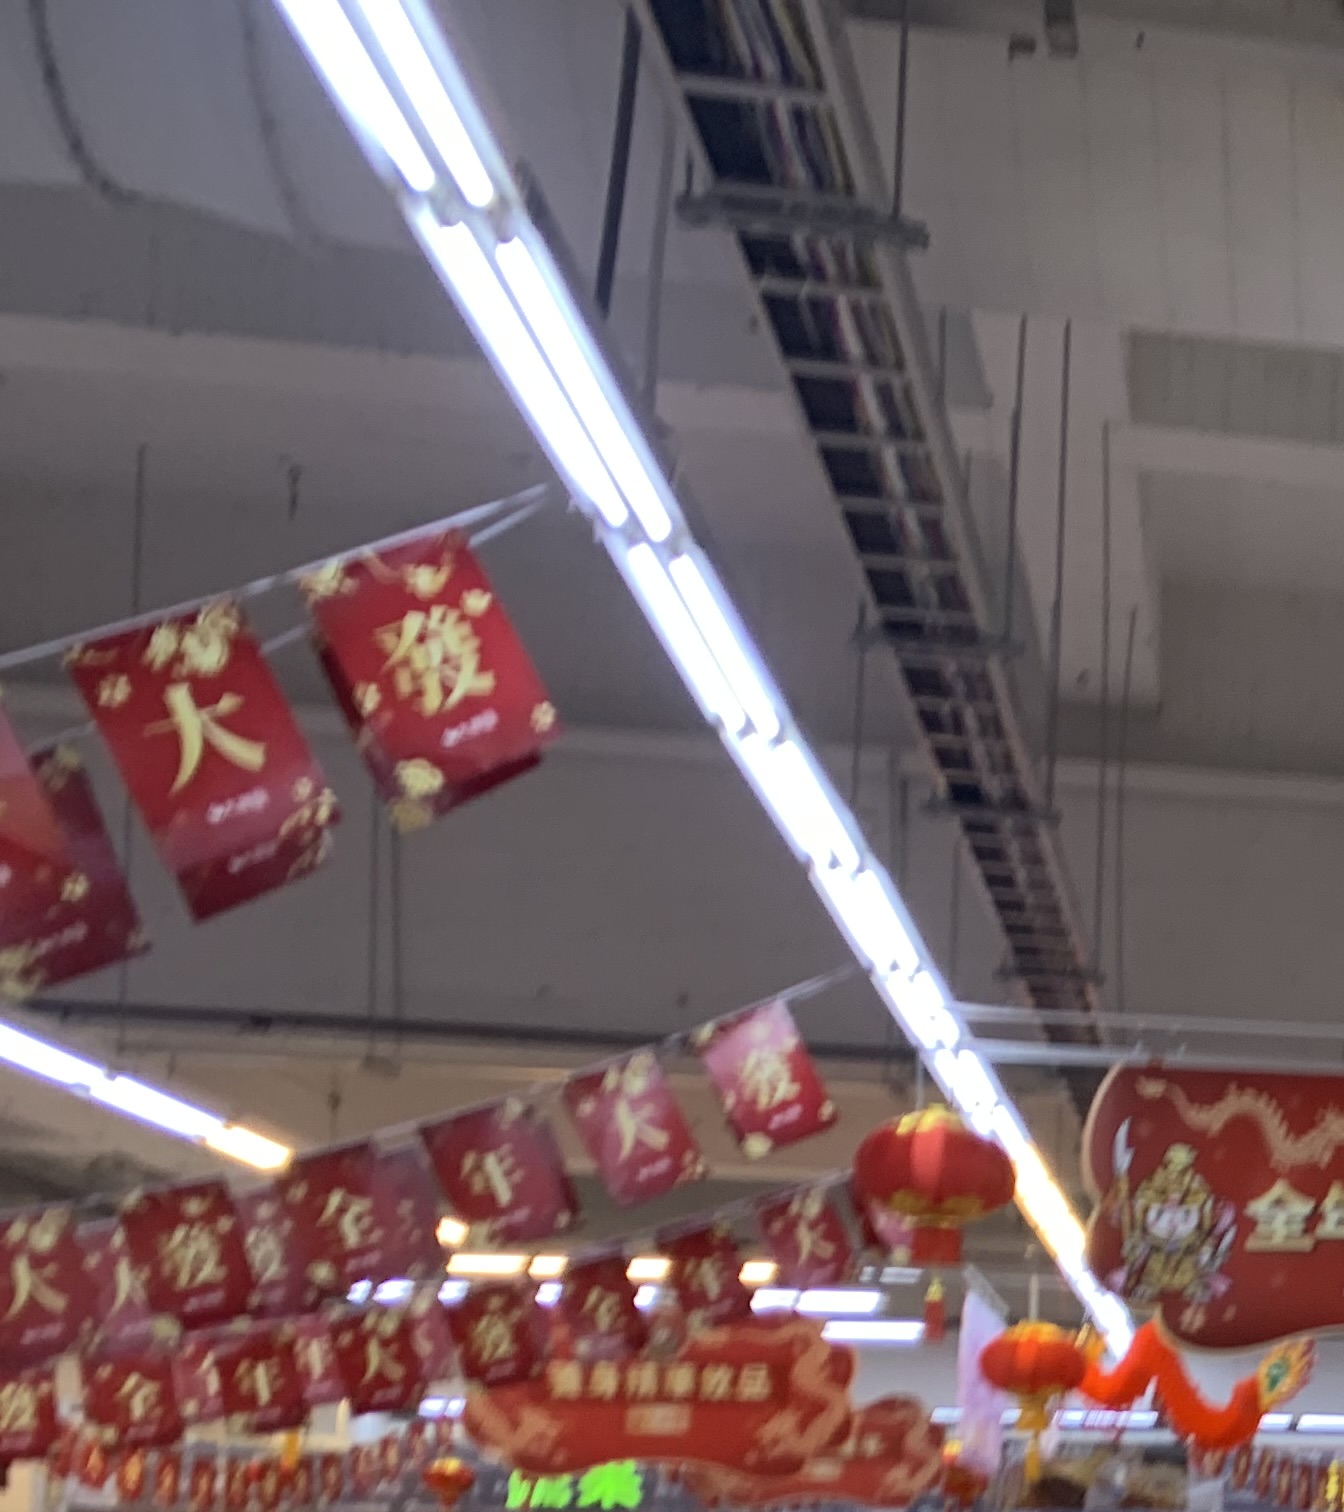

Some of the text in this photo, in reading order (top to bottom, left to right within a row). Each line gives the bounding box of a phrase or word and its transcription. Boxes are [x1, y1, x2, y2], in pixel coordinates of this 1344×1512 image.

[374, 605, 495, 717] 發
[144, 683, 266, 796] 大
[738, 1046, 800, 1109] 發
[613, 1097, 670, 1162] 大
[461, 1142, 527, 1207] 年
[4, 1255, 69, 1320] 大
[158, 1223, 227, 1290] 發
